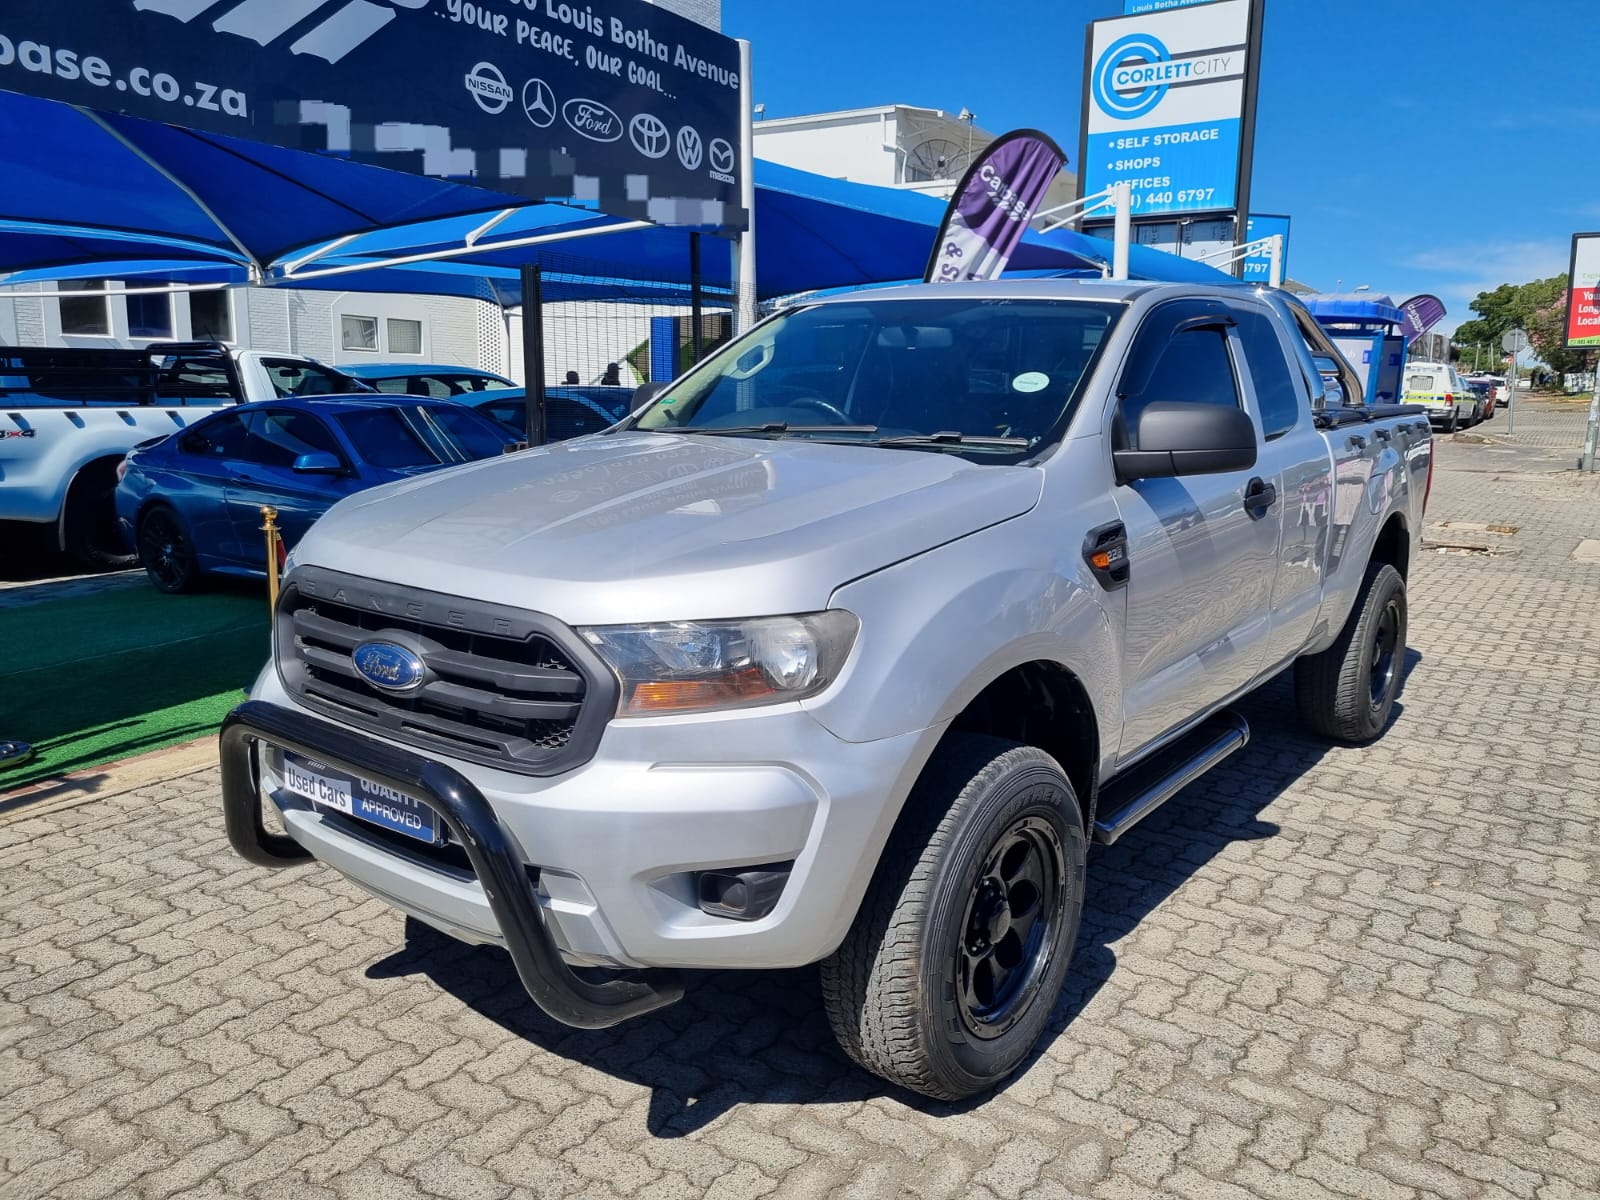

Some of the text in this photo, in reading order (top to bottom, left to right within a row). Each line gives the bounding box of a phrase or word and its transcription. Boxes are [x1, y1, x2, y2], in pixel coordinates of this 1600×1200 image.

[586, 45, 621, 77] OUR
[610, 16, 668, 62] Botha
[673, 43, 740, 90] Avenue
[1116, 56, 1231, 85] CORLETT CITY
[467, 77, 511, 98] NISSAN
[574, 103, 612, 135] Ford
[1117, 128, 1219, 149] SELF STORAGE
[1115, 157, 1161, 171] SHOPS
[1145, 191, 1173, 204] 440
[1177, 188, 1215, 202] 6797
[364, 652, 401, 682] Ford
[288, 767, 347, 808] Used Cars
[361, 798, 422, 830] APPROVED
